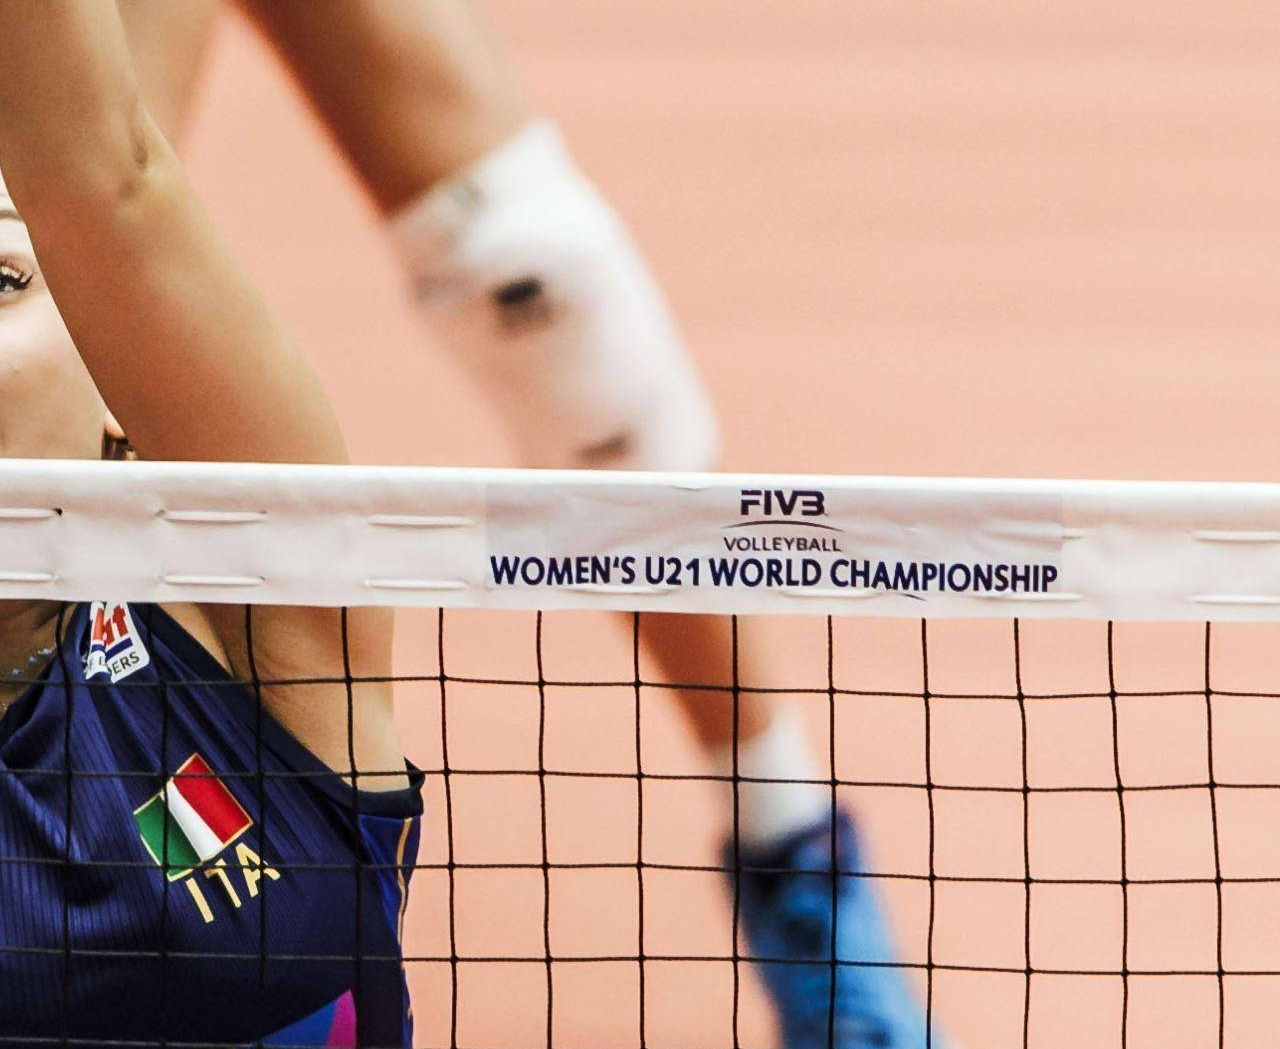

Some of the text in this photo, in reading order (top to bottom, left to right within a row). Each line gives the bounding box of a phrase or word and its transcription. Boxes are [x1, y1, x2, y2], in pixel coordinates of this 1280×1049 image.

[740, 489, 825, 517] FIVB
[723, 536, 842, 552] VOLLEYBALL
[490, 555, 1058, 593] WOMEN'S U21 WORLD CHAMPIONSHIP
[185, 842, 281, 924] ITA
